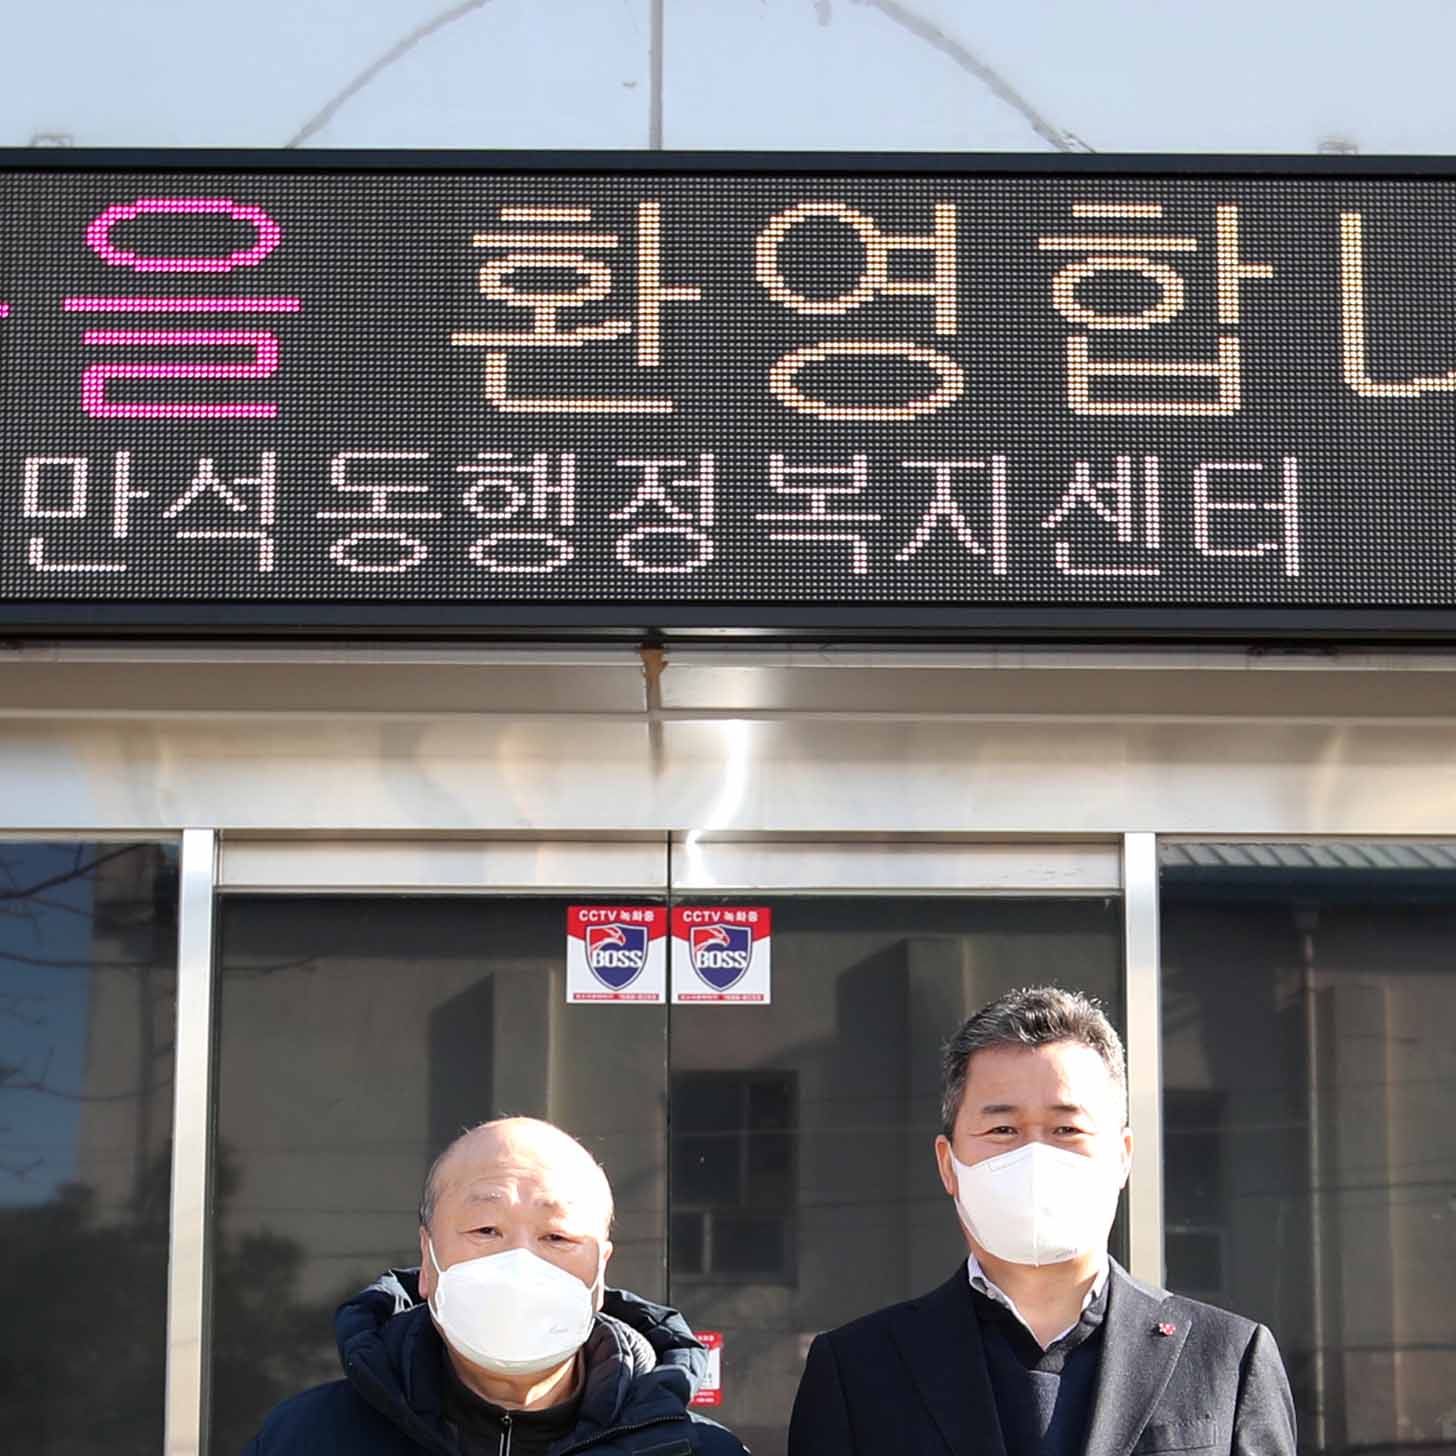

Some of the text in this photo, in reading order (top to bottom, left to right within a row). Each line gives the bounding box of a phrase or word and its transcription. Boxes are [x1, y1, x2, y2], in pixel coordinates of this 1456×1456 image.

[22, 450, 1301, 578] 만석동행정복지센터
[579, 910, 617, 922] CCTV
[683, 911, 720, 923] CCTV
[593, 950, 642, 968] BOSS
[697, 951, 746, 968] BOSS
